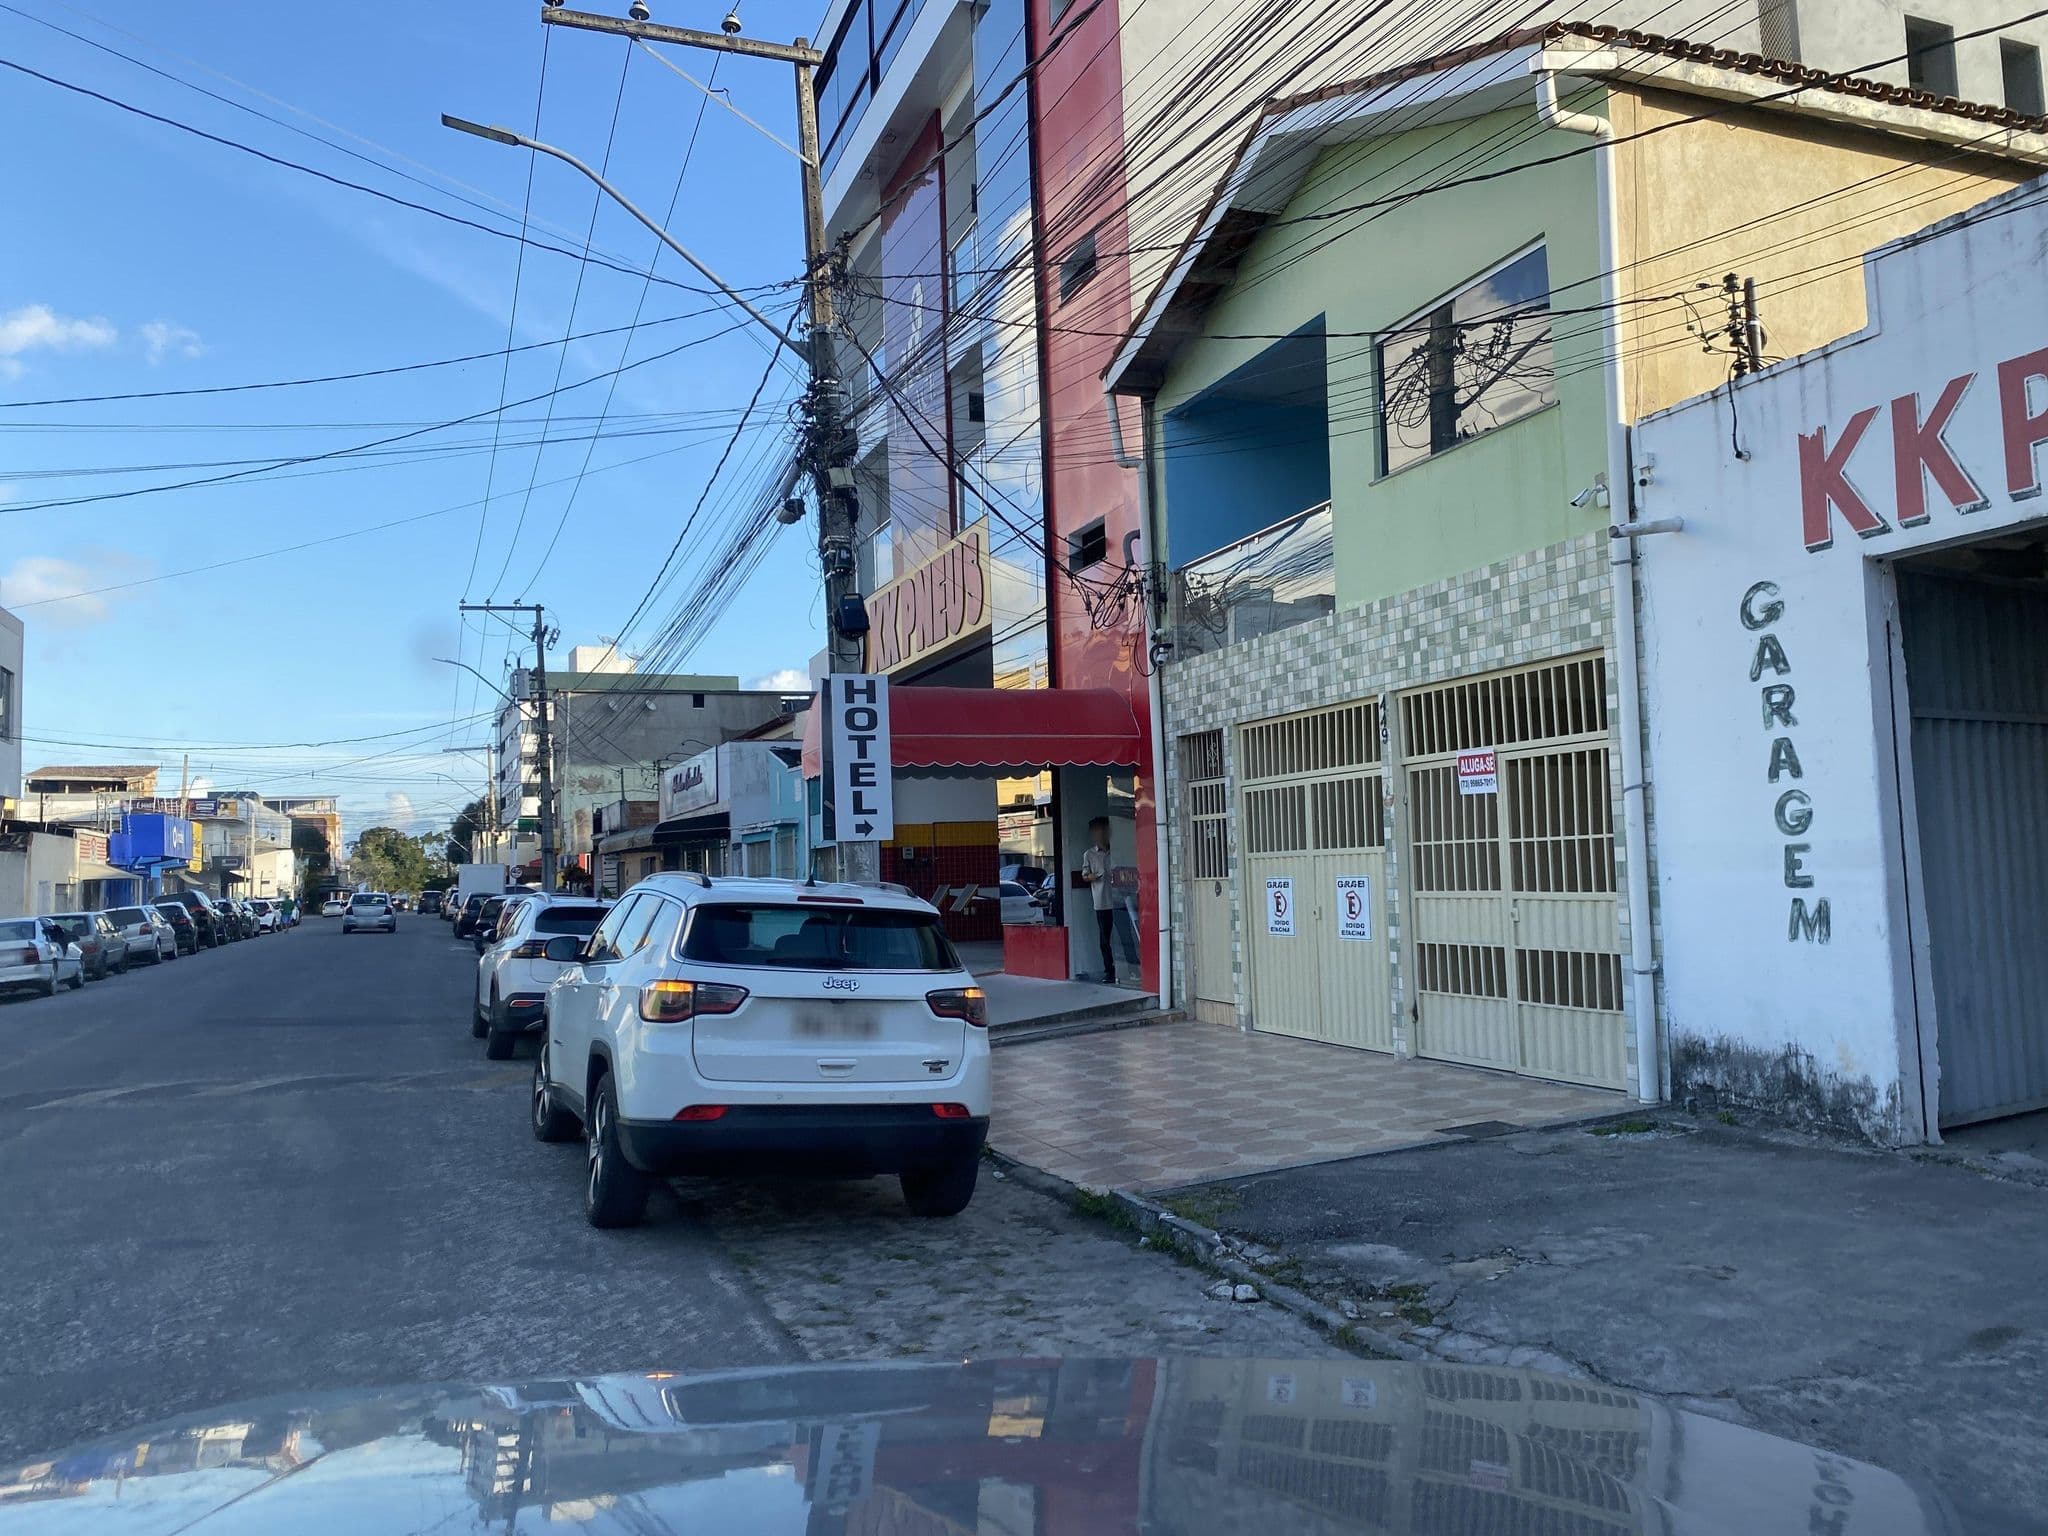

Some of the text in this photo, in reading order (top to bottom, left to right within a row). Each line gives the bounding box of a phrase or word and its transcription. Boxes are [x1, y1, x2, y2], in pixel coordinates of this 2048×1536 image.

[844, 679, 878, 815] HOTEL
[1460, 756, 1495, 774] ALUGA-SE
[1740, 580, 1832, 945] GARAGEM
[823, 976, 861, 992] Jeep
